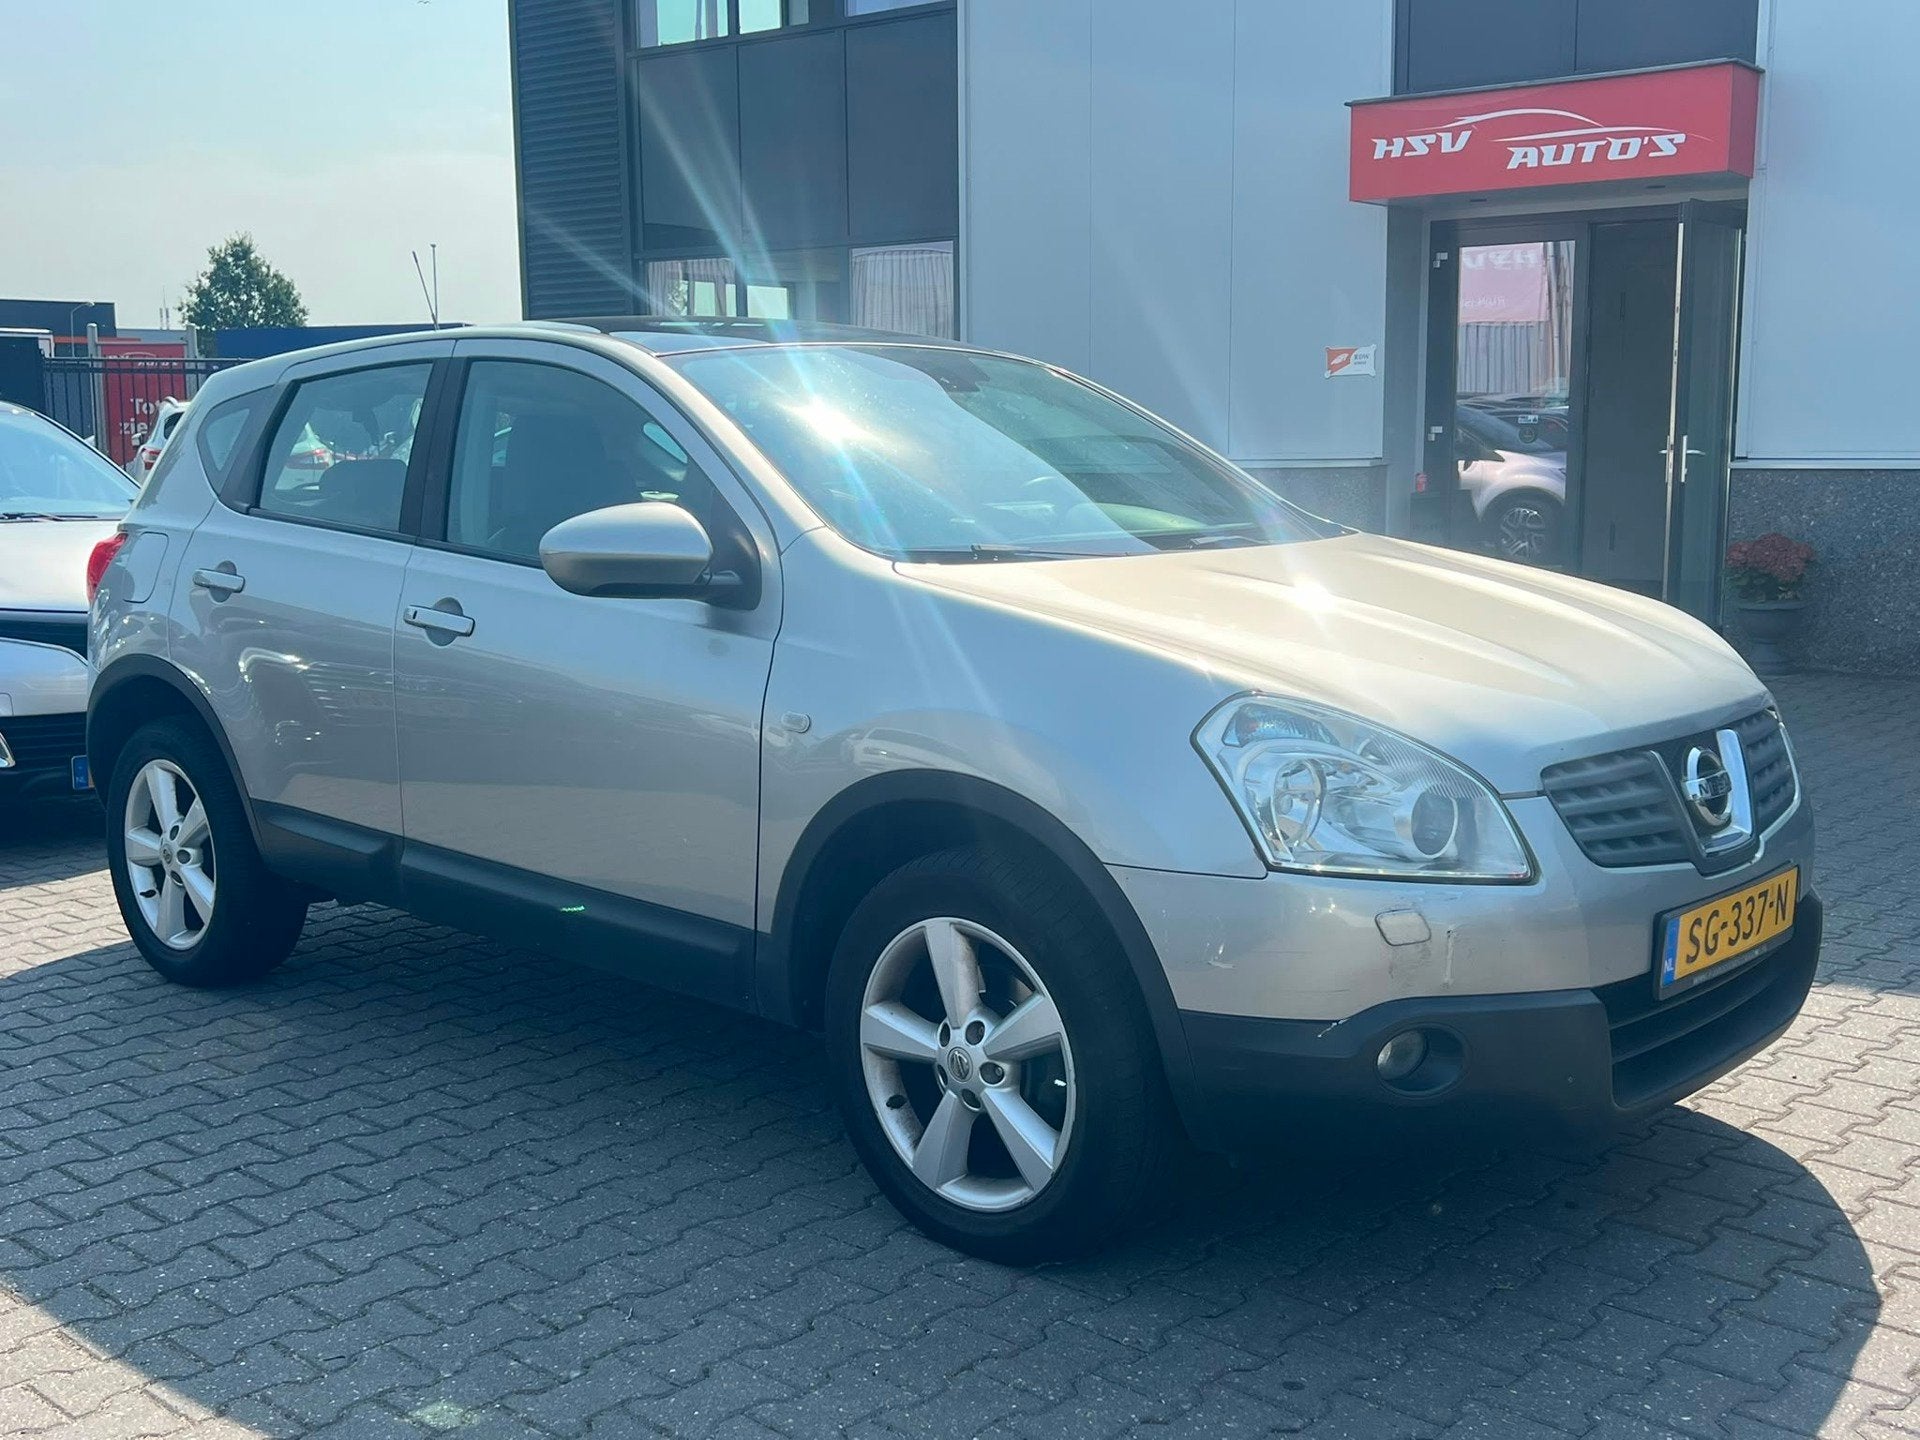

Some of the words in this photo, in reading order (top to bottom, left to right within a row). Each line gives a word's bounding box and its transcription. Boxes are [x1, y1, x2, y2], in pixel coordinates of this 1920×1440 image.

[1371, 130, 1472, 160] HSV
[1506, 133, 1686, 169] AUTO'S
[130, 398, 160, 415] To
[1686, 879, 1789, 964] SG-337-N
